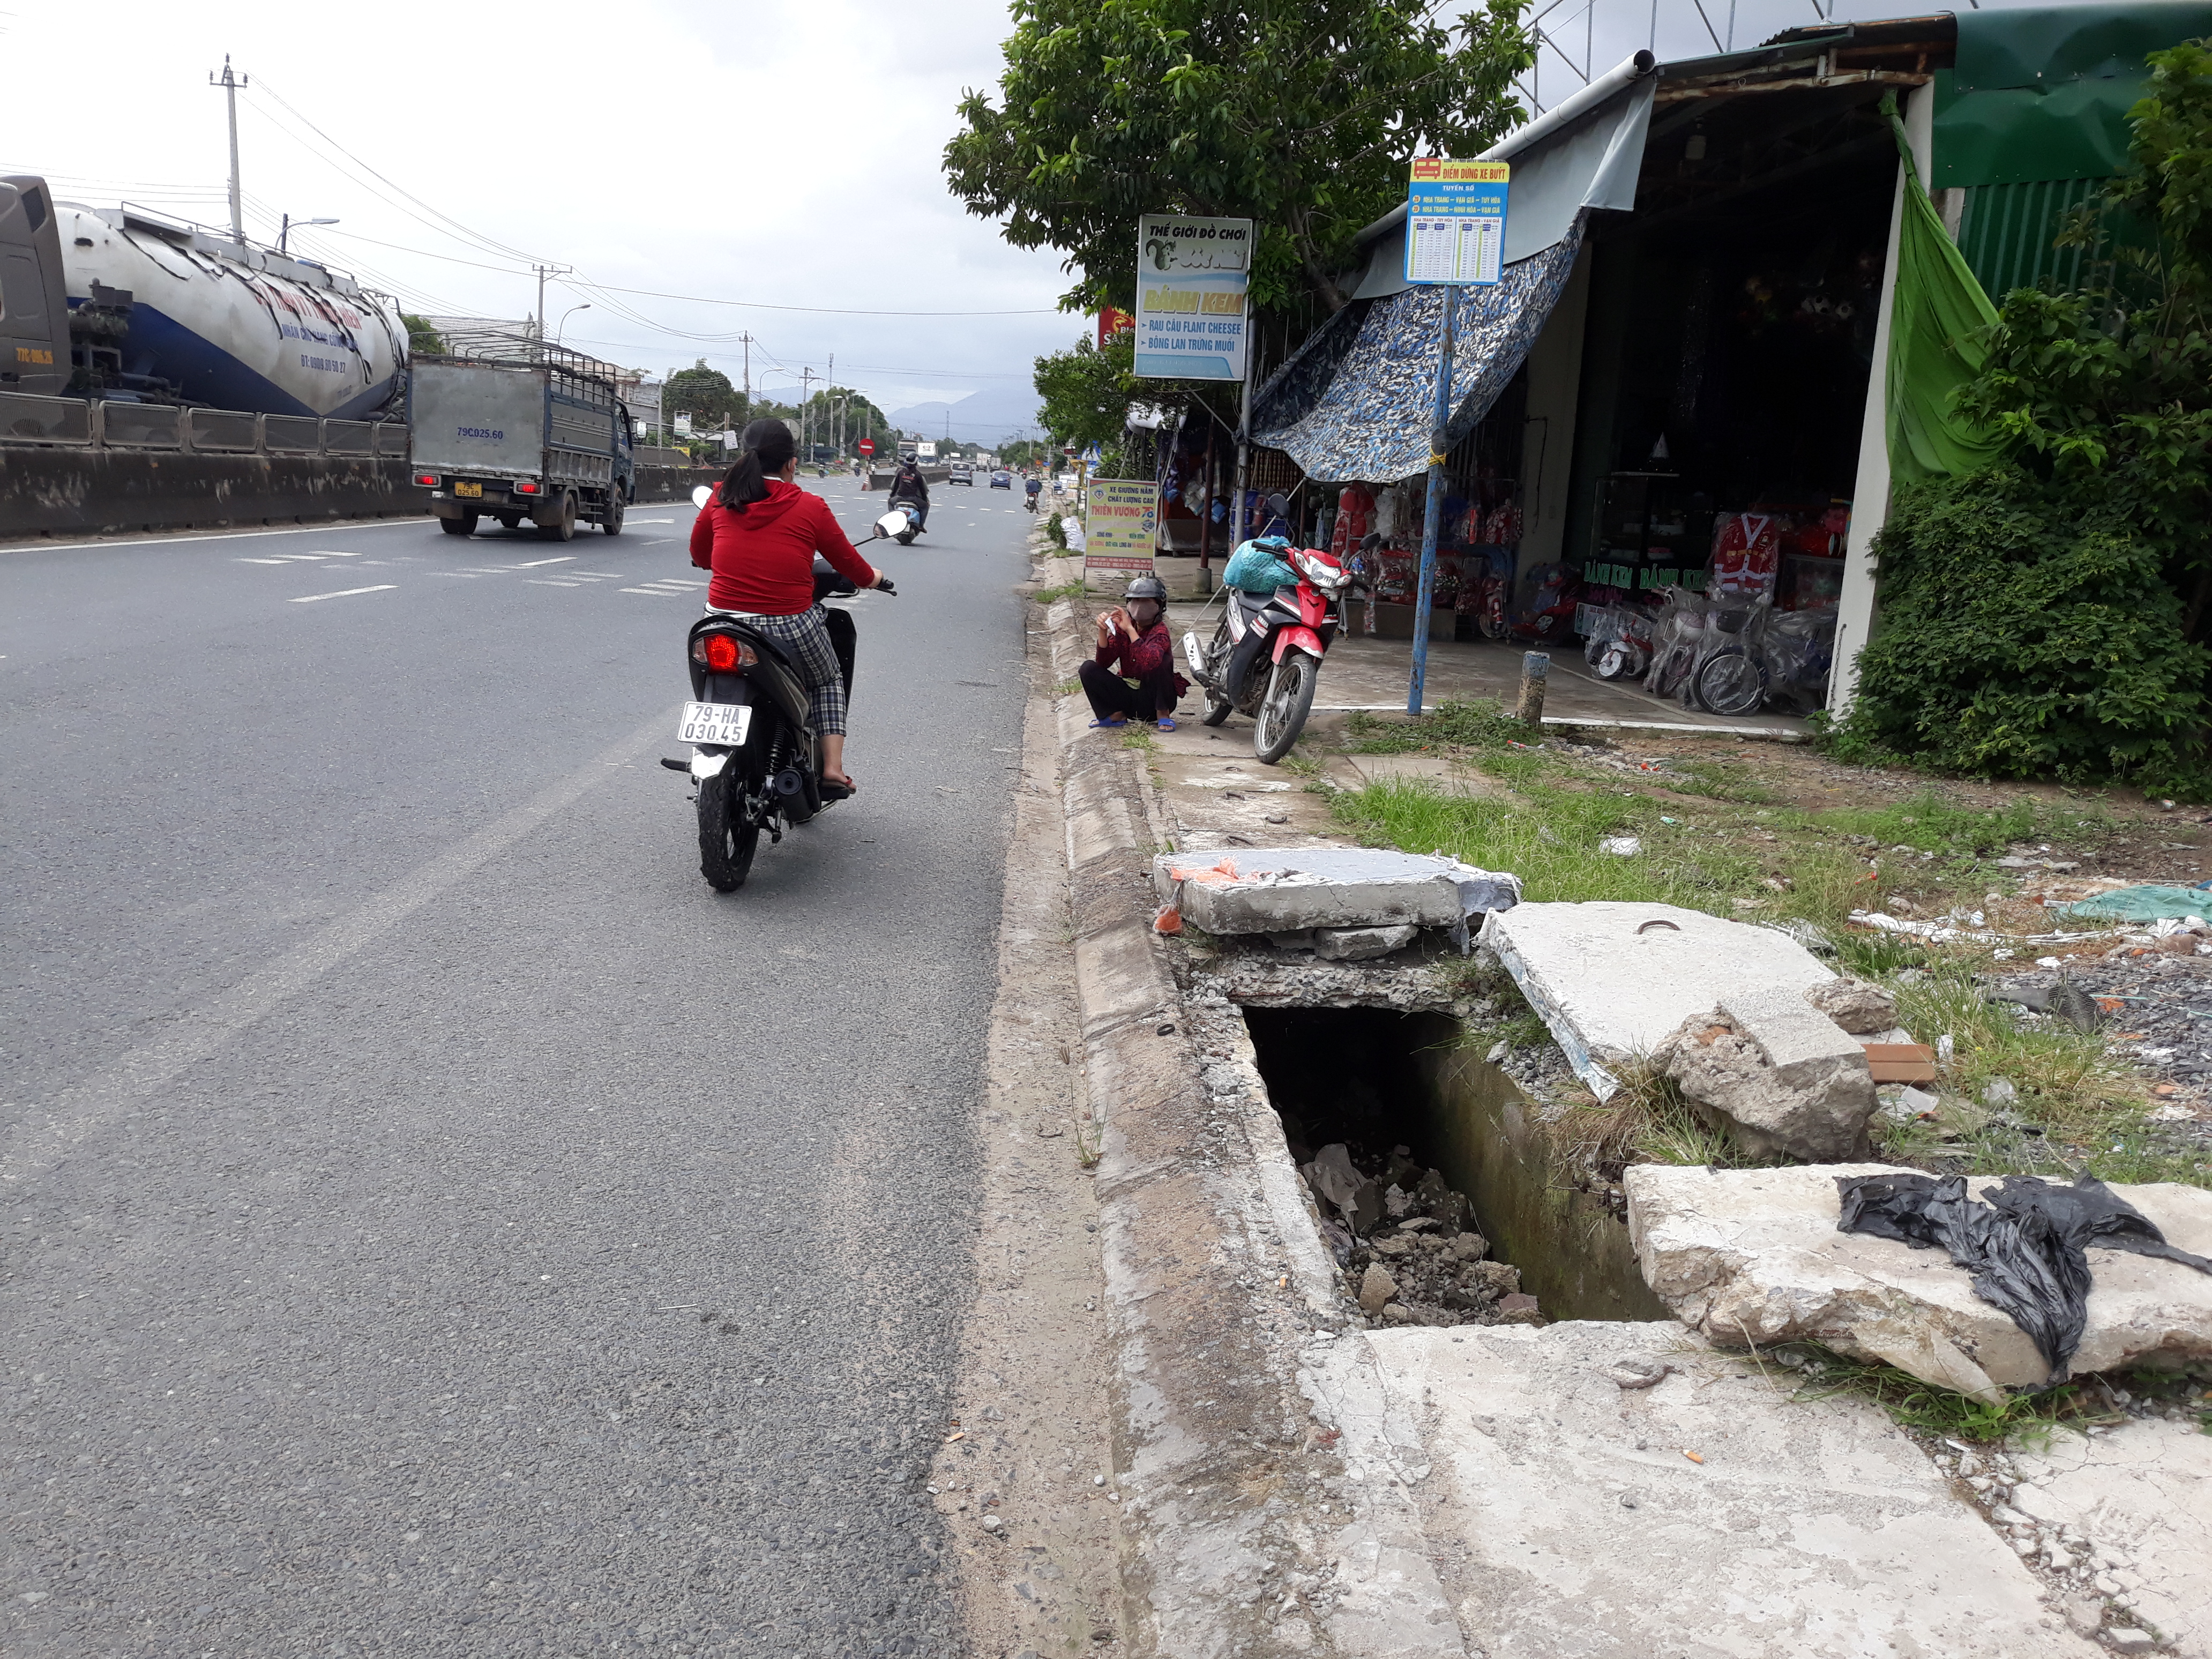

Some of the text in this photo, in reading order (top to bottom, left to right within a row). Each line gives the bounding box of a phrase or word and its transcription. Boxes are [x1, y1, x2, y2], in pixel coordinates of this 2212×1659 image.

[1443, 164, 1506, 180] ĐIỂM DỪNG XE BUÝT
[1149, 221, 1247, 241] THẾ GIỚI ĐỒ CHƠI
[1143, 285, 1244, 317] BÁNH KEM
[1149, 319, 1164, 331] RAU
[1183, 321, 1206, 333] FLANT
[1208, 322, 1241, 335] CHEESEE
[1148, 335, 1169, 349] BÔNG
[1171, 338, 1186, 349] LAN
[1583, 558, 1633, 589] BÁNH KEM
[1639, 563, 1679, 589] BÁNH
[693, 706, 739, 724] 79-HA
[685, 723, 742, 742] 030.45
